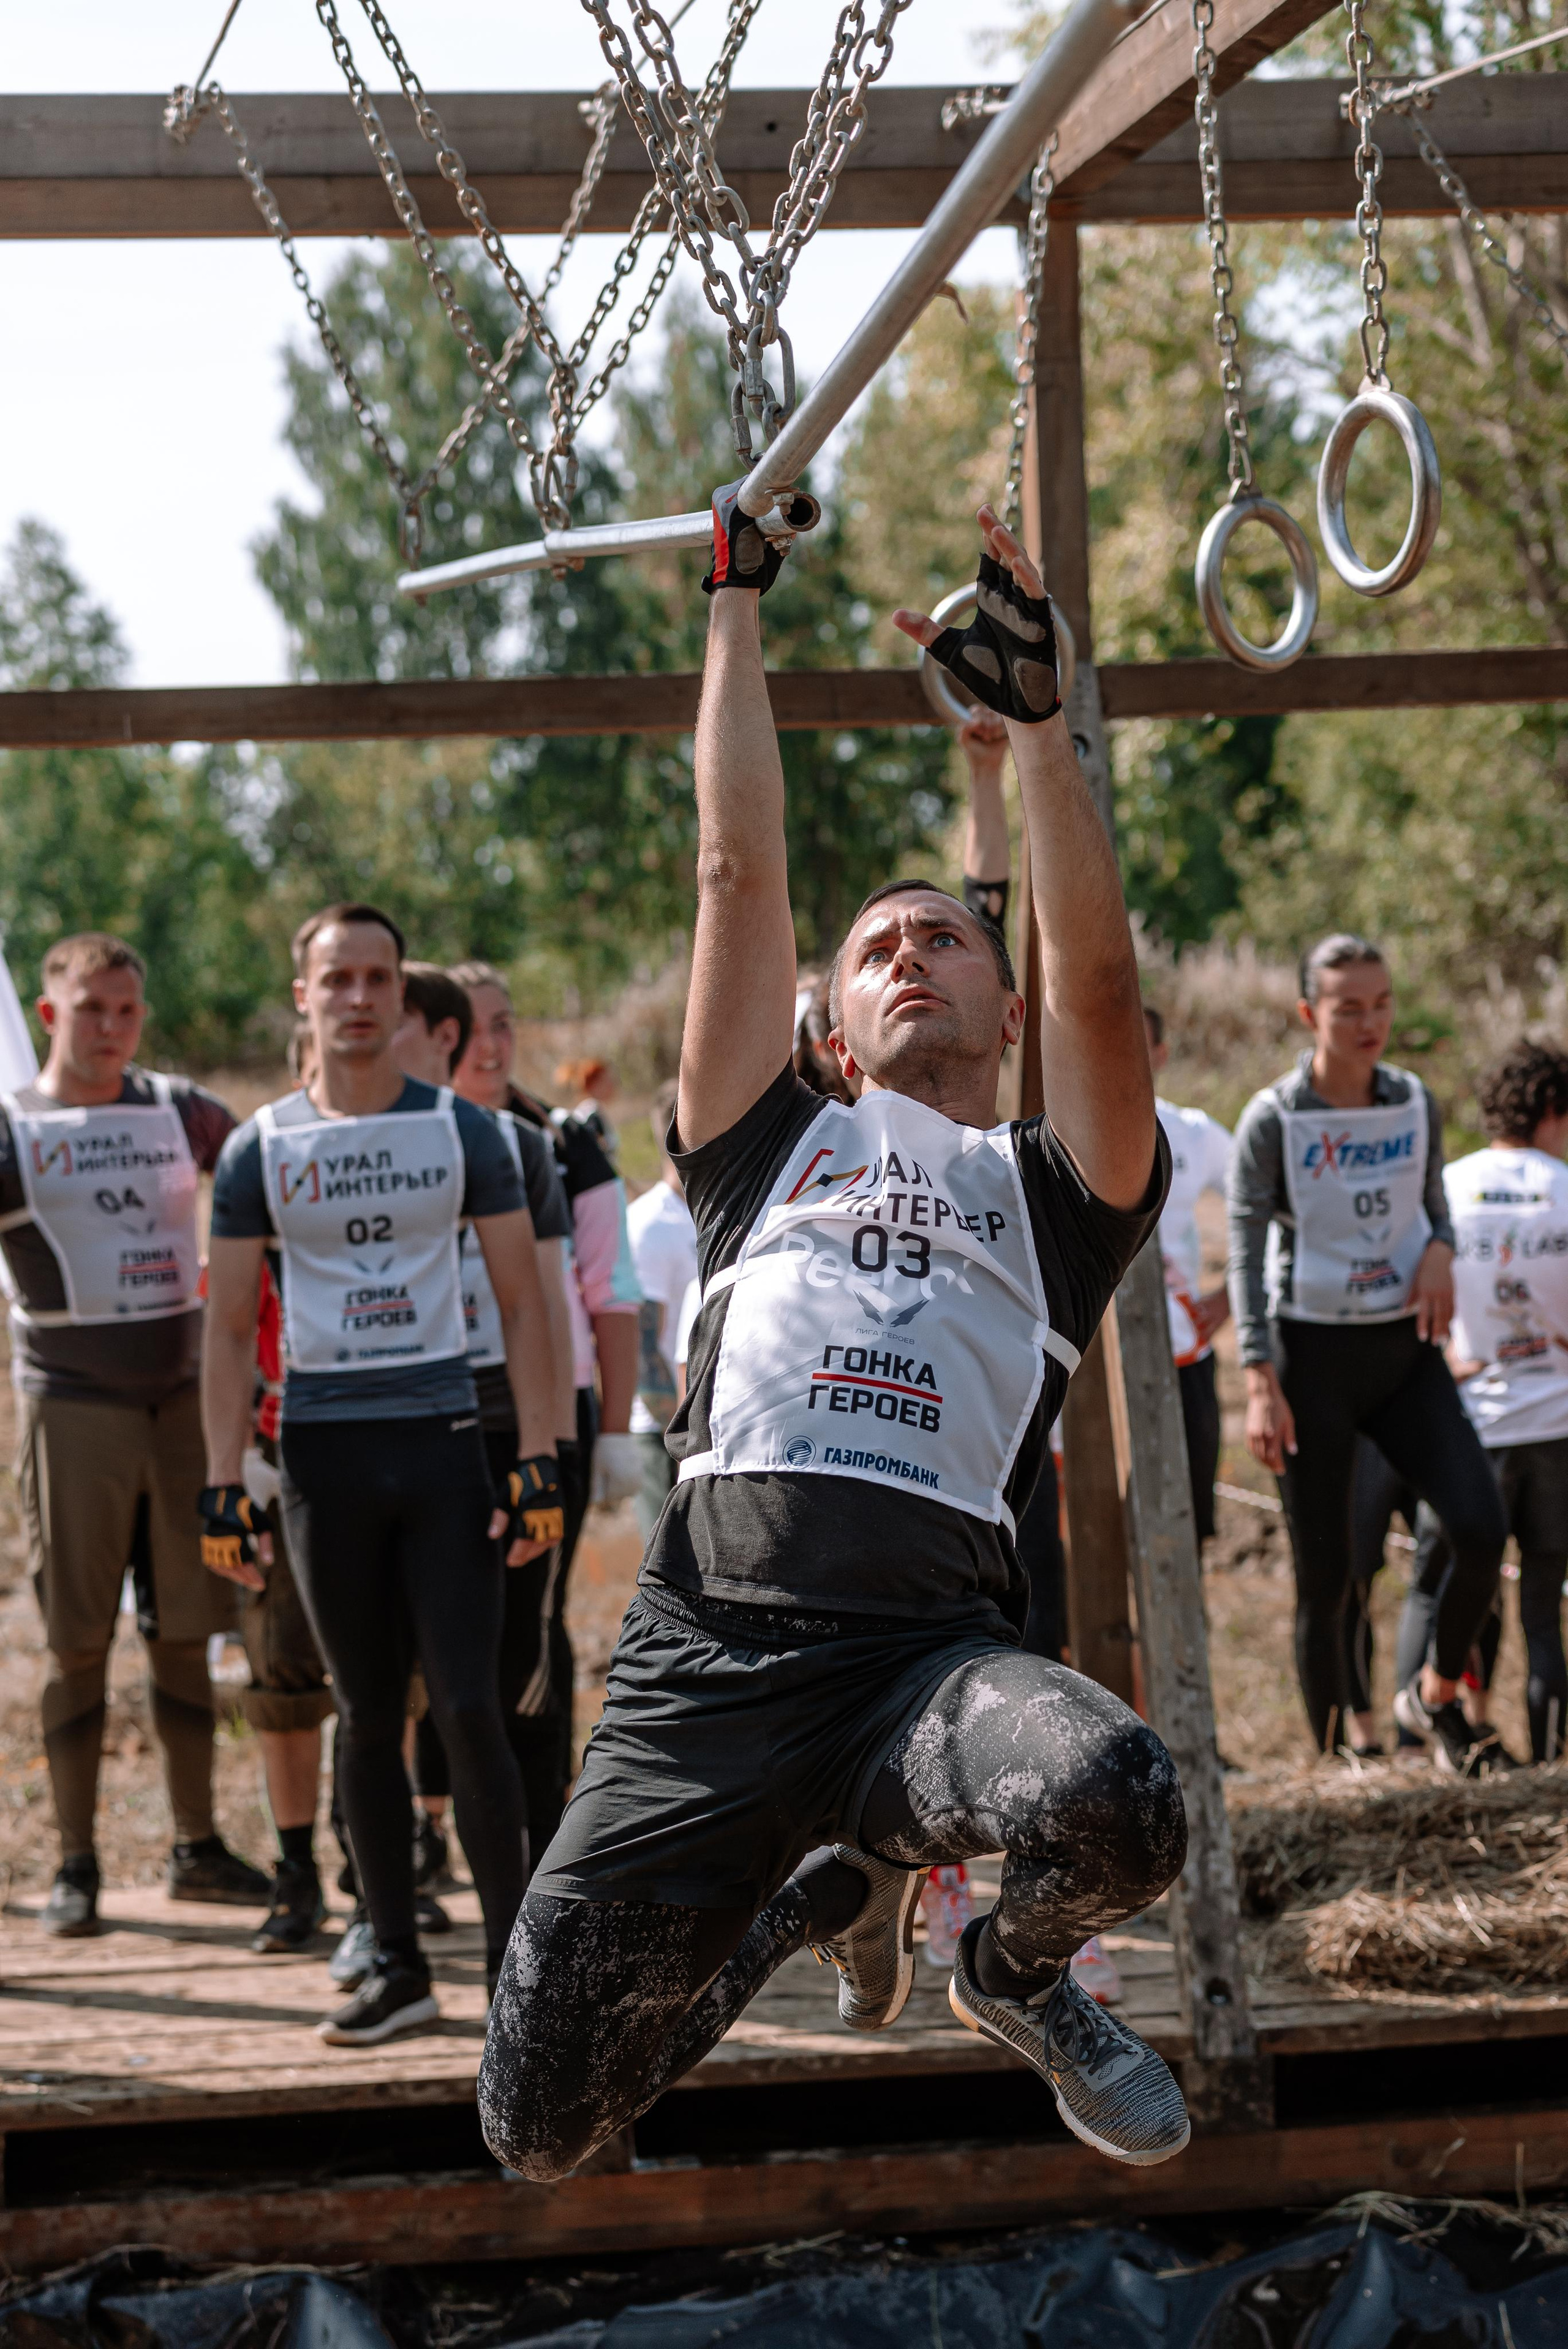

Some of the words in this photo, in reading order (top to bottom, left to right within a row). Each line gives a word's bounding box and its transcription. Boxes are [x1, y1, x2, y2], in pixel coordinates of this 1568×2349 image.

[325, 1149, 392, 1174] УРАЛ
[865, 1151, 933, 1189] УАЛ
[326, 1167, 447, 1201] ИНТЕРЬЕР
[95, 1187, 146, 1215] 04
[1354, 1187, 1390, 1219] 05
[347, 1215, 394, 1245] 02
[851, 1224, 932, 1279] 03
[345, 1284, 409, 1306] ГОНКА
[341, 1309, 418, 1331] ГЕРОЕВ
[882, 1331, 915, 1345] ГЕРОЕВ
[823, 1345, 937, 1390] ГОНКА
[808, 1384, 941, 1433] ГЕРОЕВ
[824, 1447, 940, 1489] ГАЗПРОМБАНК
